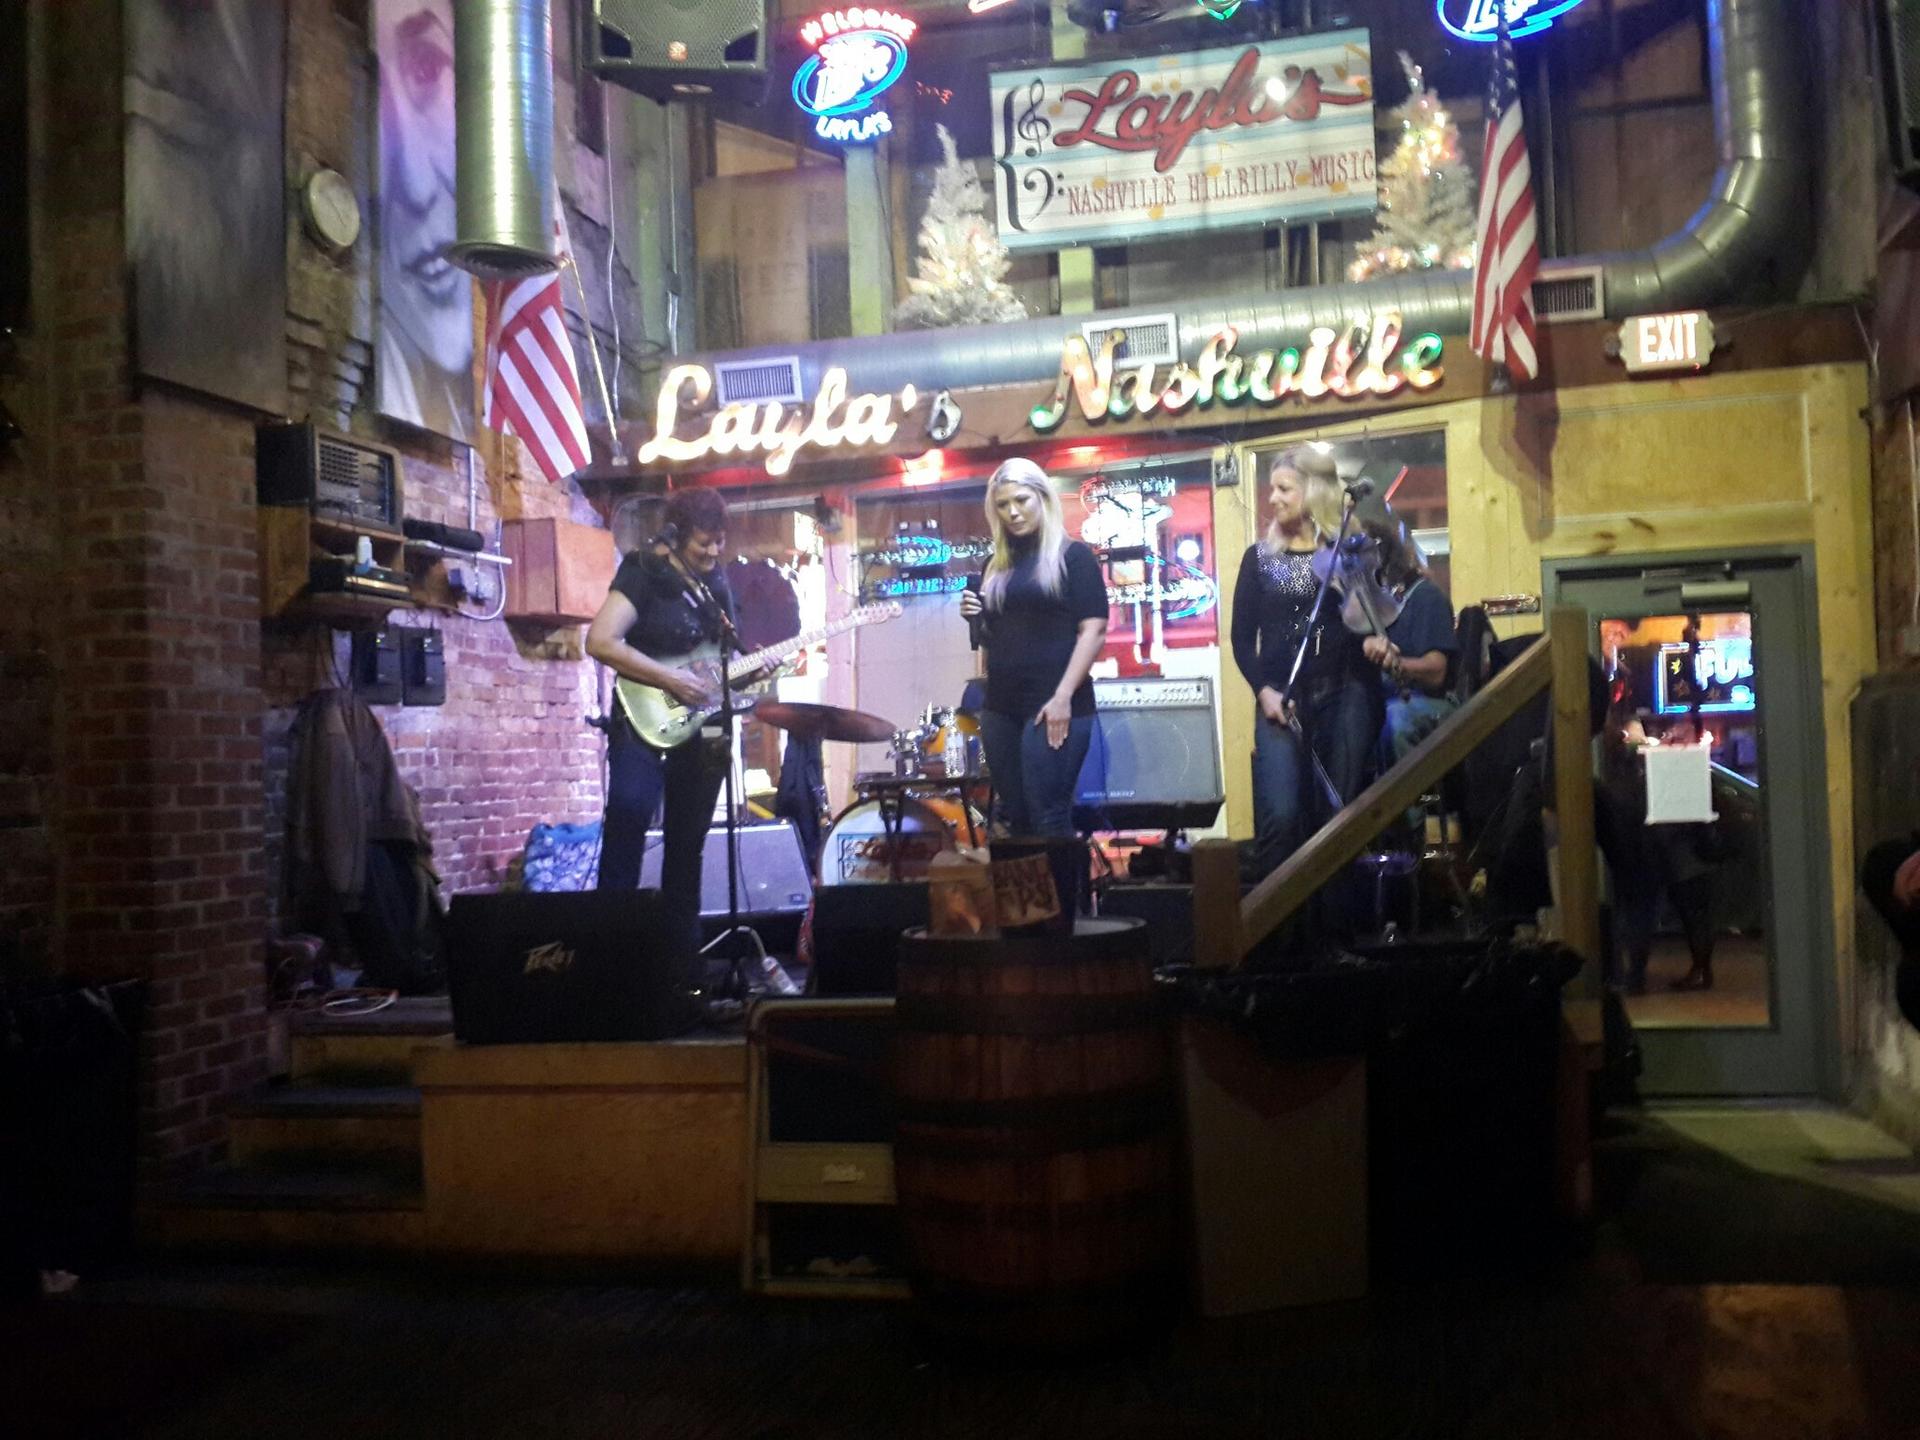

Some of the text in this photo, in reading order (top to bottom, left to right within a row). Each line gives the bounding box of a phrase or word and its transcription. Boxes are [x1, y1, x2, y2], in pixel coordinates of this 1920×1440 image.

[801, 7, 917, 46] WELCOME
[1052, 45, 1371, 174] Layla's
[1067, 150, 1374, 216] NASHVILLE HILLBILLY MUSIC
[1638, 313, 1699, 363] EXIT
[638, 309, 1444, 476] Layla's Nashville
